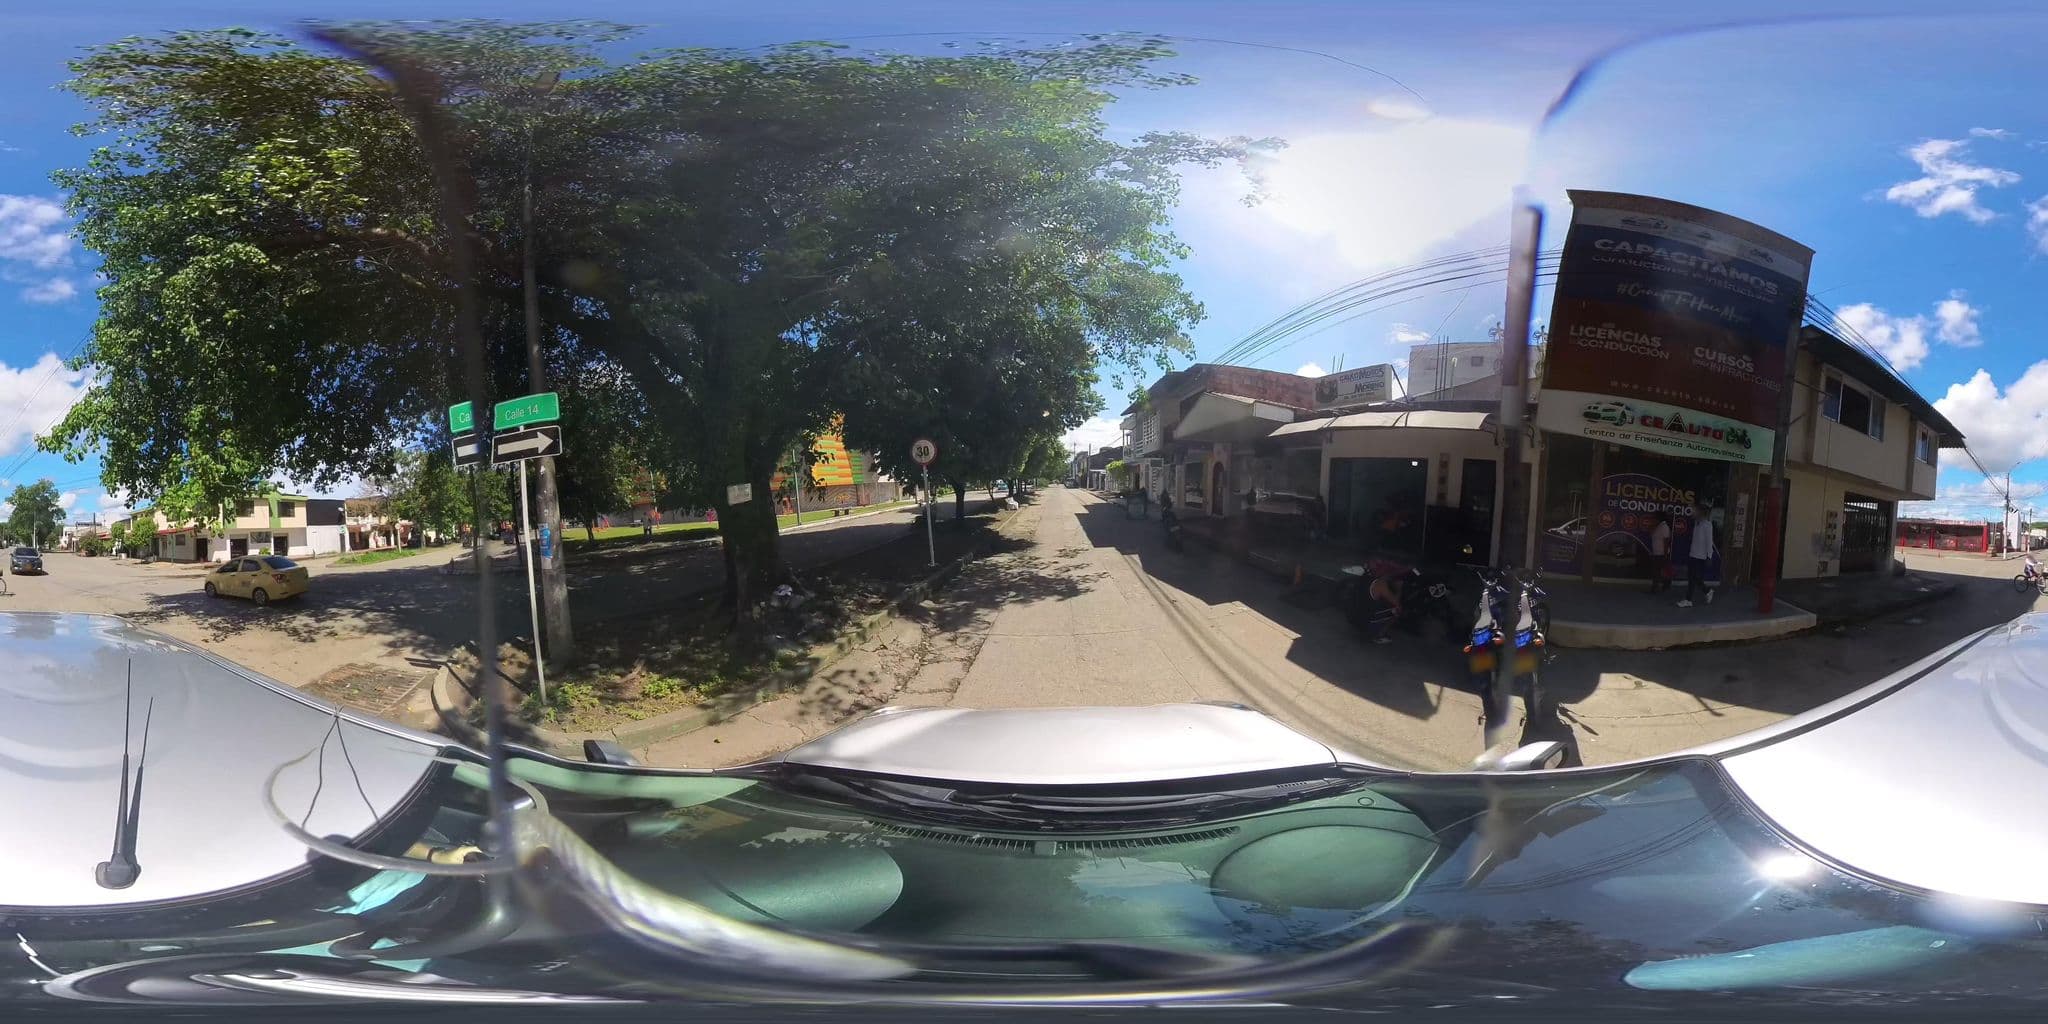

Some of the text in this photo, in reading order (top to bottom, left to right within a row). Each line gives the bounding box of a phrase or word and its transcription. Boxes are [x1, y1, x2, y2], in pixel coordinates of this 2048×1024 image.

[1593, 238, 1779, 295] CAPACITAMOS
[1570, 324, 1663, 348] LICENCIAS
[1694, 346, 1755, 373] CURSOS
[459, 411, 473, 424] Cal
[505, 404, 539, 421] Calle 14
[1583, 427, 1616, 439] Centro
[1634, 434, 1684, 449] Enseñanza
[1640, 413, 1724, 441] CEAUTO
[917, 445, 930, 457] 30
[1606, 481, 1696, 504] LICENCIAS
[1608, 499, 1694, 517] DE CONDUCCIO
